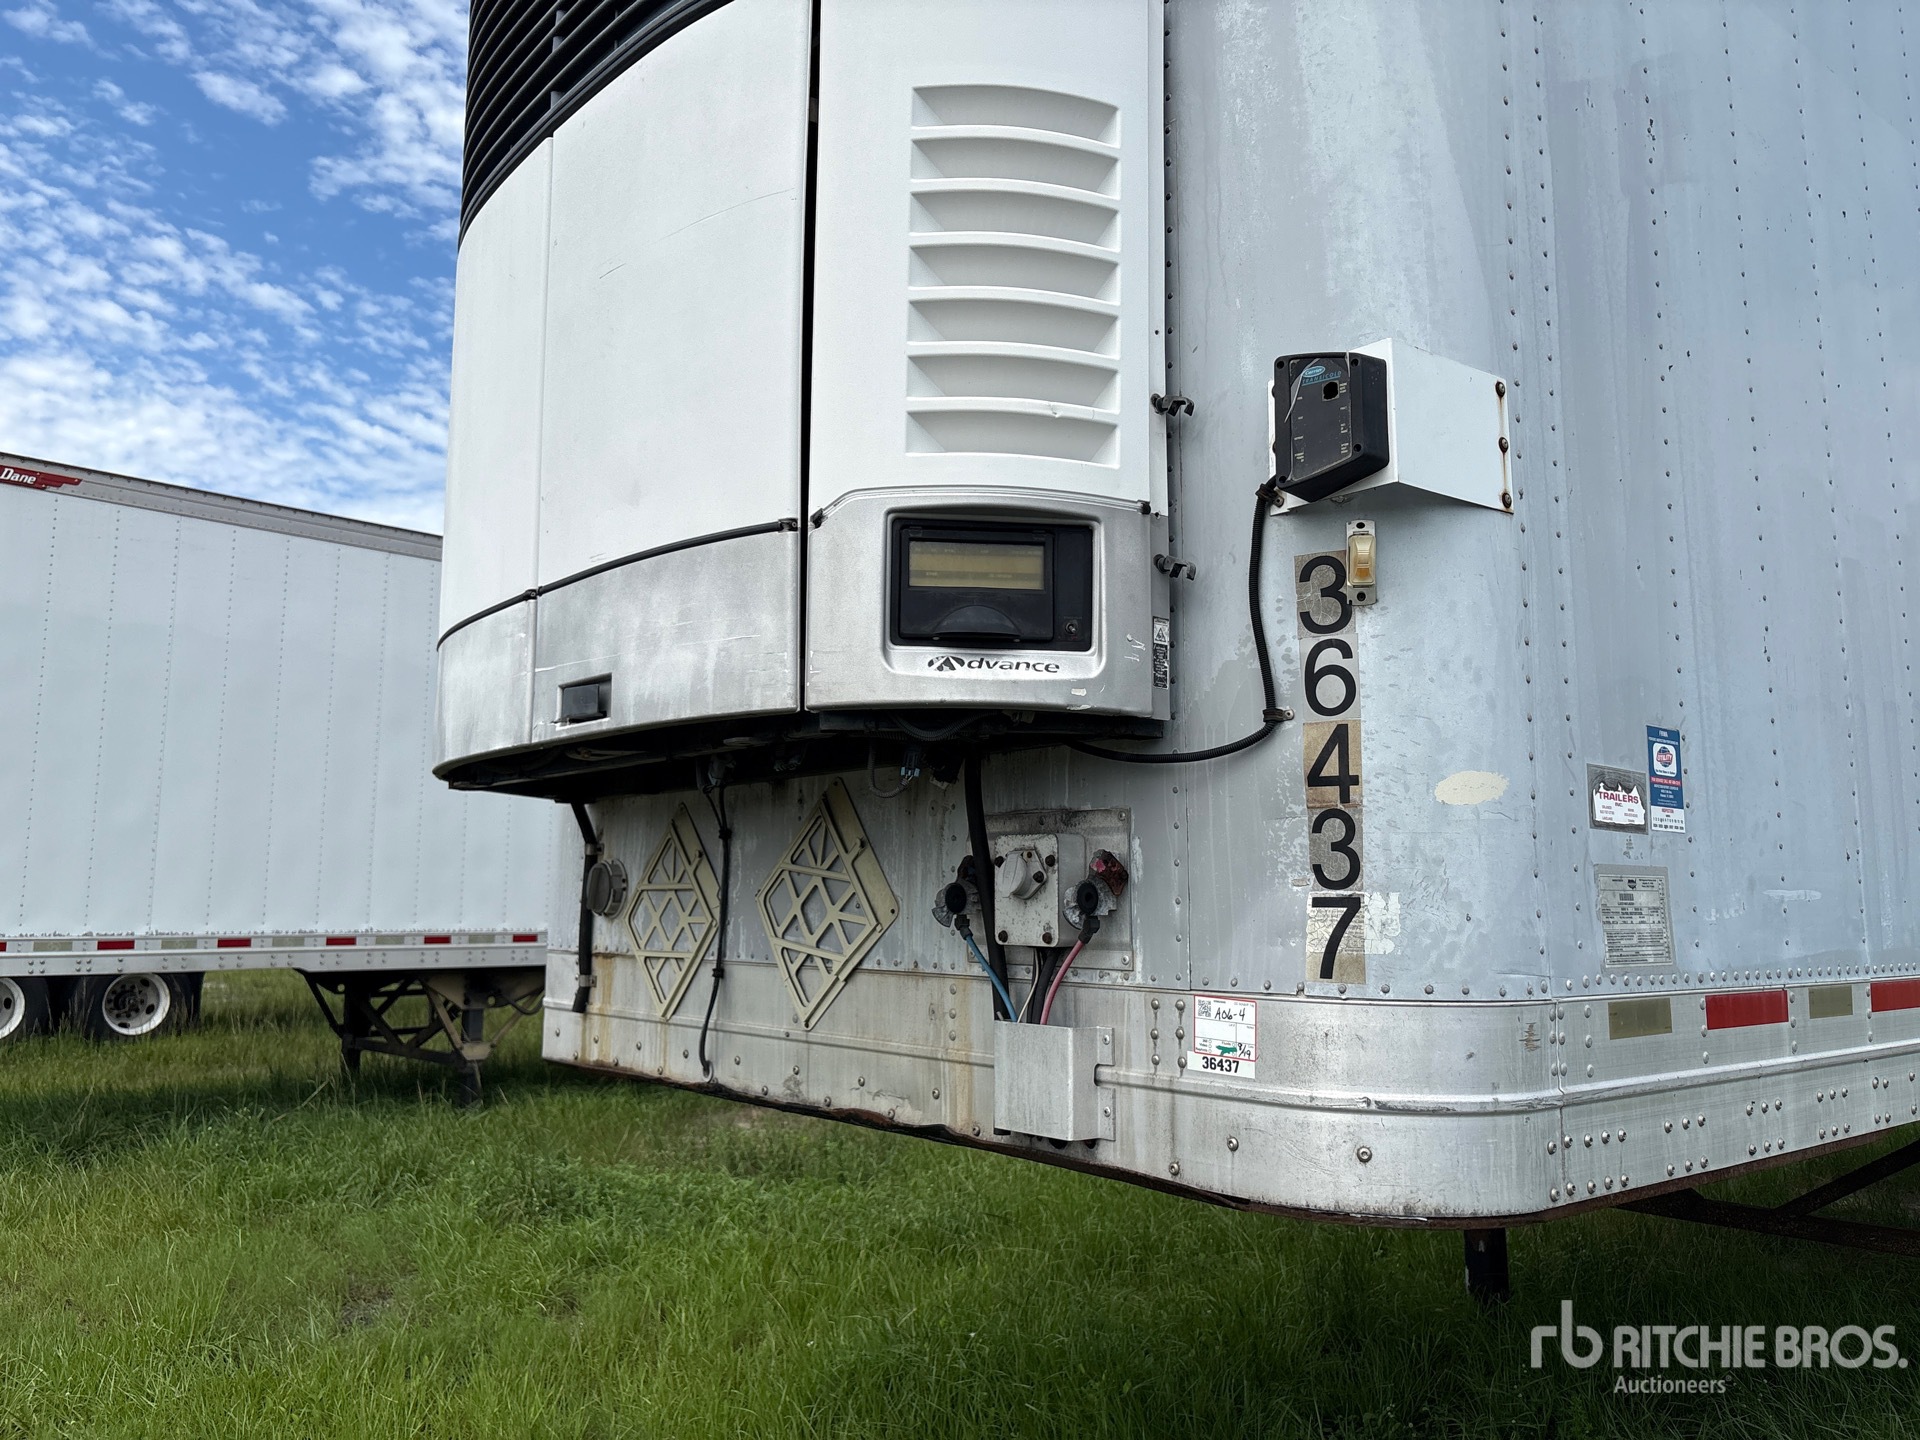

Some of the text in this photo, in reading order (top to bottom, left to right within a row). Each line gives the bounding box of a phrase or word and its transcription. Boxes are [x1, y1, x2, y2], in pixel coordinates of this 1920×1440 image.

[0, 467, 37, 485] Dane
[927, 655, 1061, 674] Advance
[1599, 791, 1638, 804] TRAILERS
[1202, 1056, 1239, 1073] 36437
